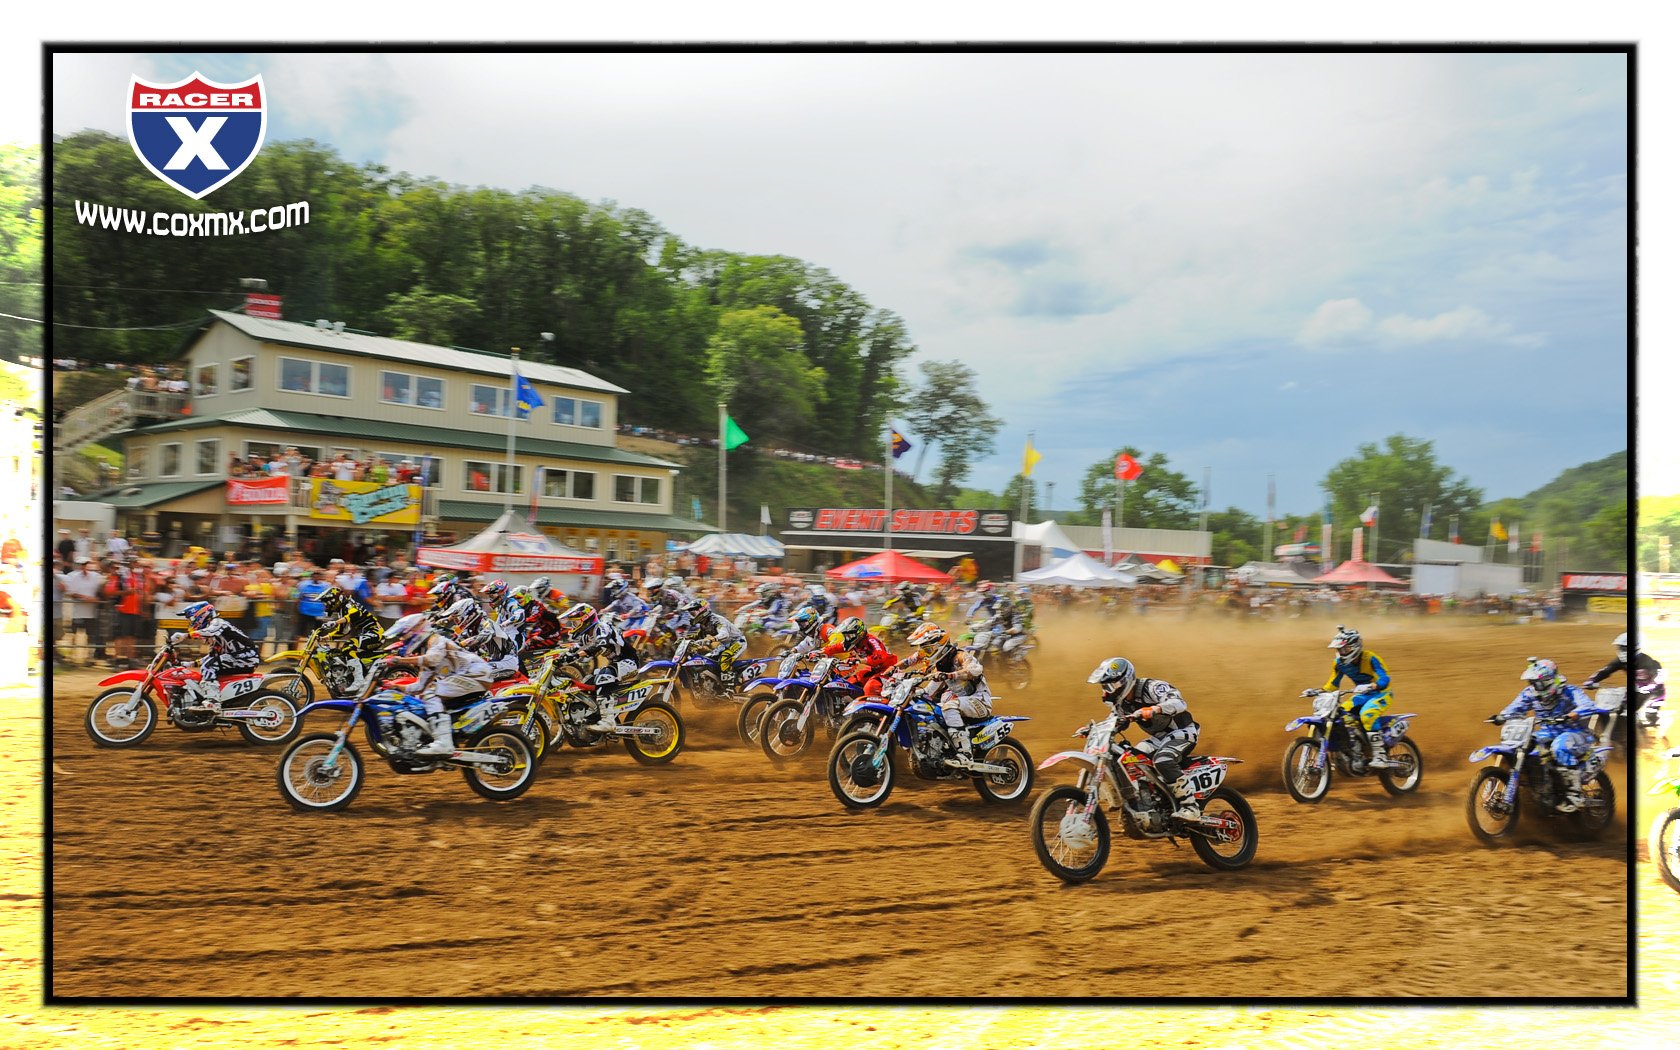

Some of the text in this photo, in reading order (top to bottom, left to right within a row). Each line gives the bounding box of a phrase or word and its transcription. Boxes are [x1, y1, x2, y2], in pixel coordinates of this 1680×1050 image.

[814, 508, 888, 530] EVENT
[889, 508, 978, 533] SHIRTS
[746, 665, 762, 679] 32
[232, 680, 254, 696] 29
[628, 687, 647, 701] 712
[996, 723, 1011, 740] 55
[1189, 767, 1222, 791] 167
